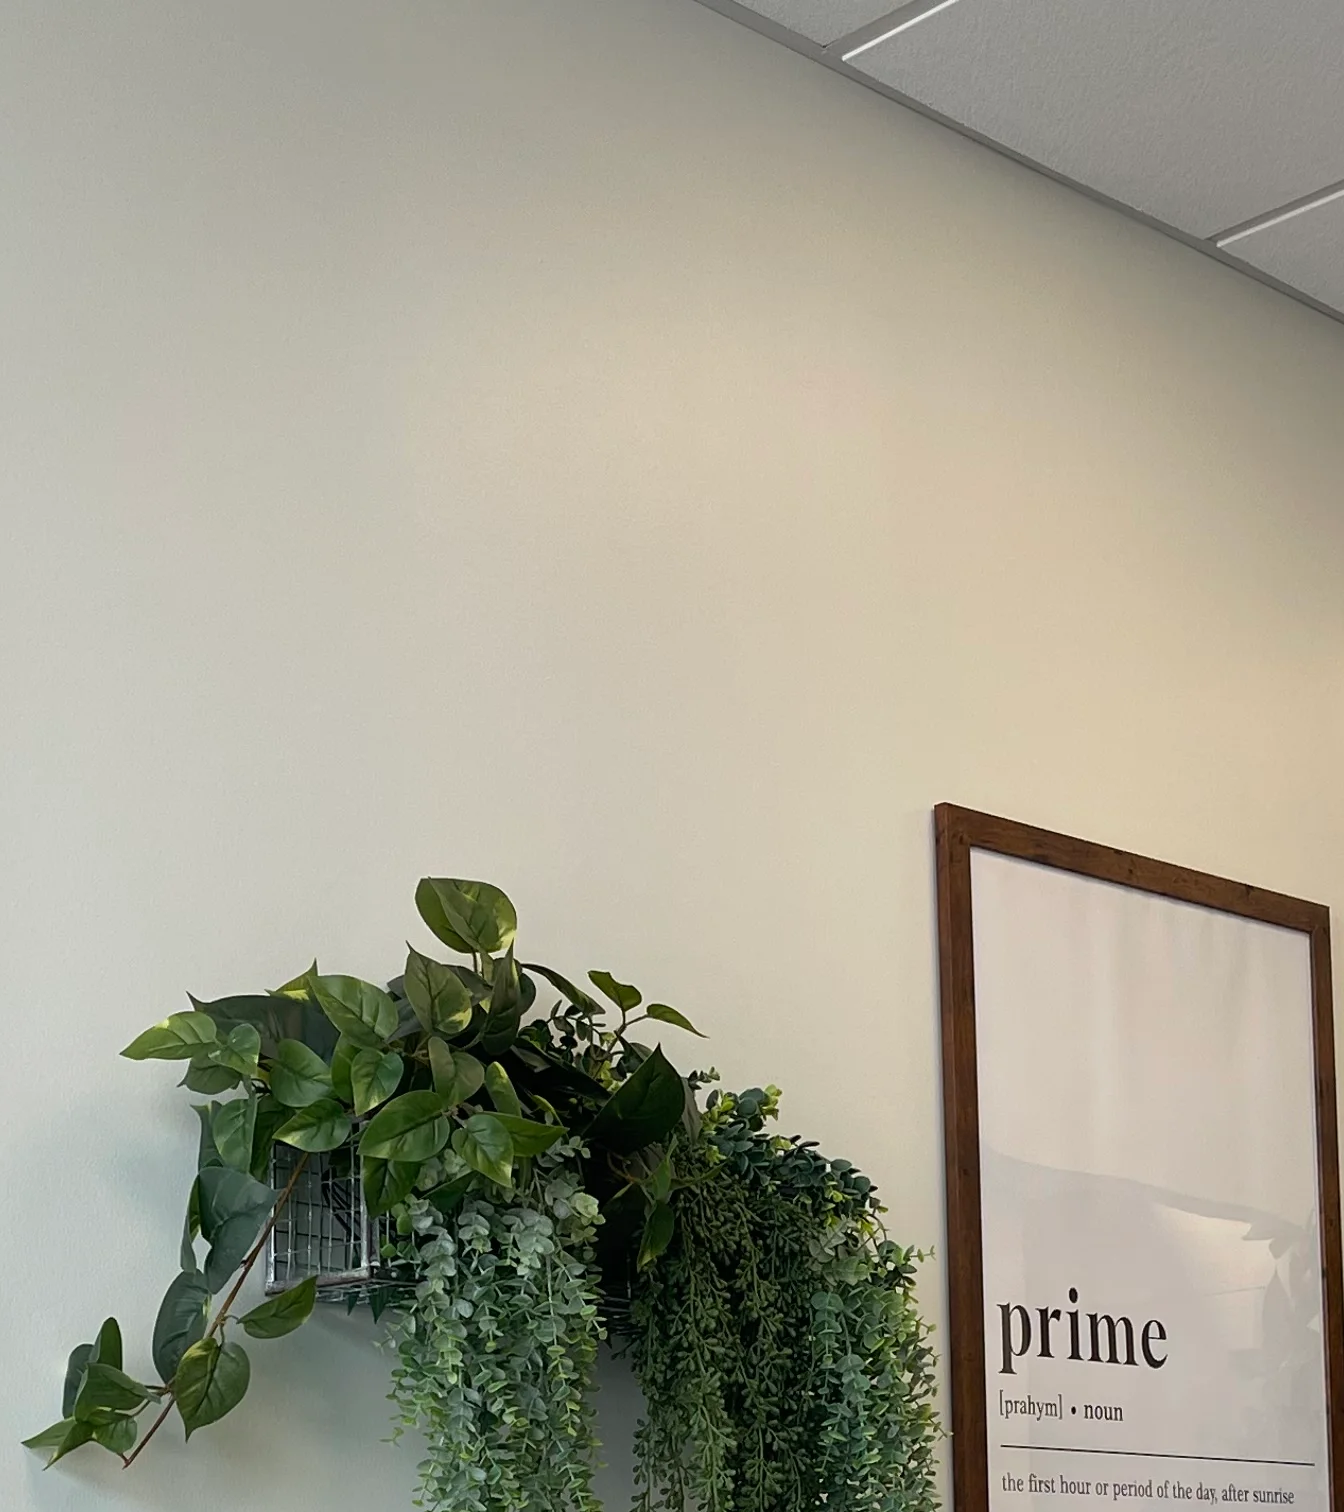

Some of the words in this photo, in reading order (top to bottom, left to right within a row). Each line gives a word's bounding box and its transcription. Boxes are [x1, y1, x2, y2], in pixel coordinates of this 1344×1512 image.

[997, 1287, 1168, 1374] prime
[999, 1389, 1063, 1421] [prahym]
[1084, 1404, 1123, 1421] noun
[1002, 1472, 1024, 1493] the
[1028, 1473, 1056, 1493] first
[1059, 1475, 1091, 1495] hour
[1095, 1482, 1109, 1496] or
[1113, 1480, 1153, 1501] period
[1157, 1480, 1170, 1498] of
[1173, 1481, 1193, 1499] the
[1196, 1482, 1217, 1505] day,
[1222, 1483, 1249, 1502] after
[1253, 1487, 1295, 1505] sunrise
